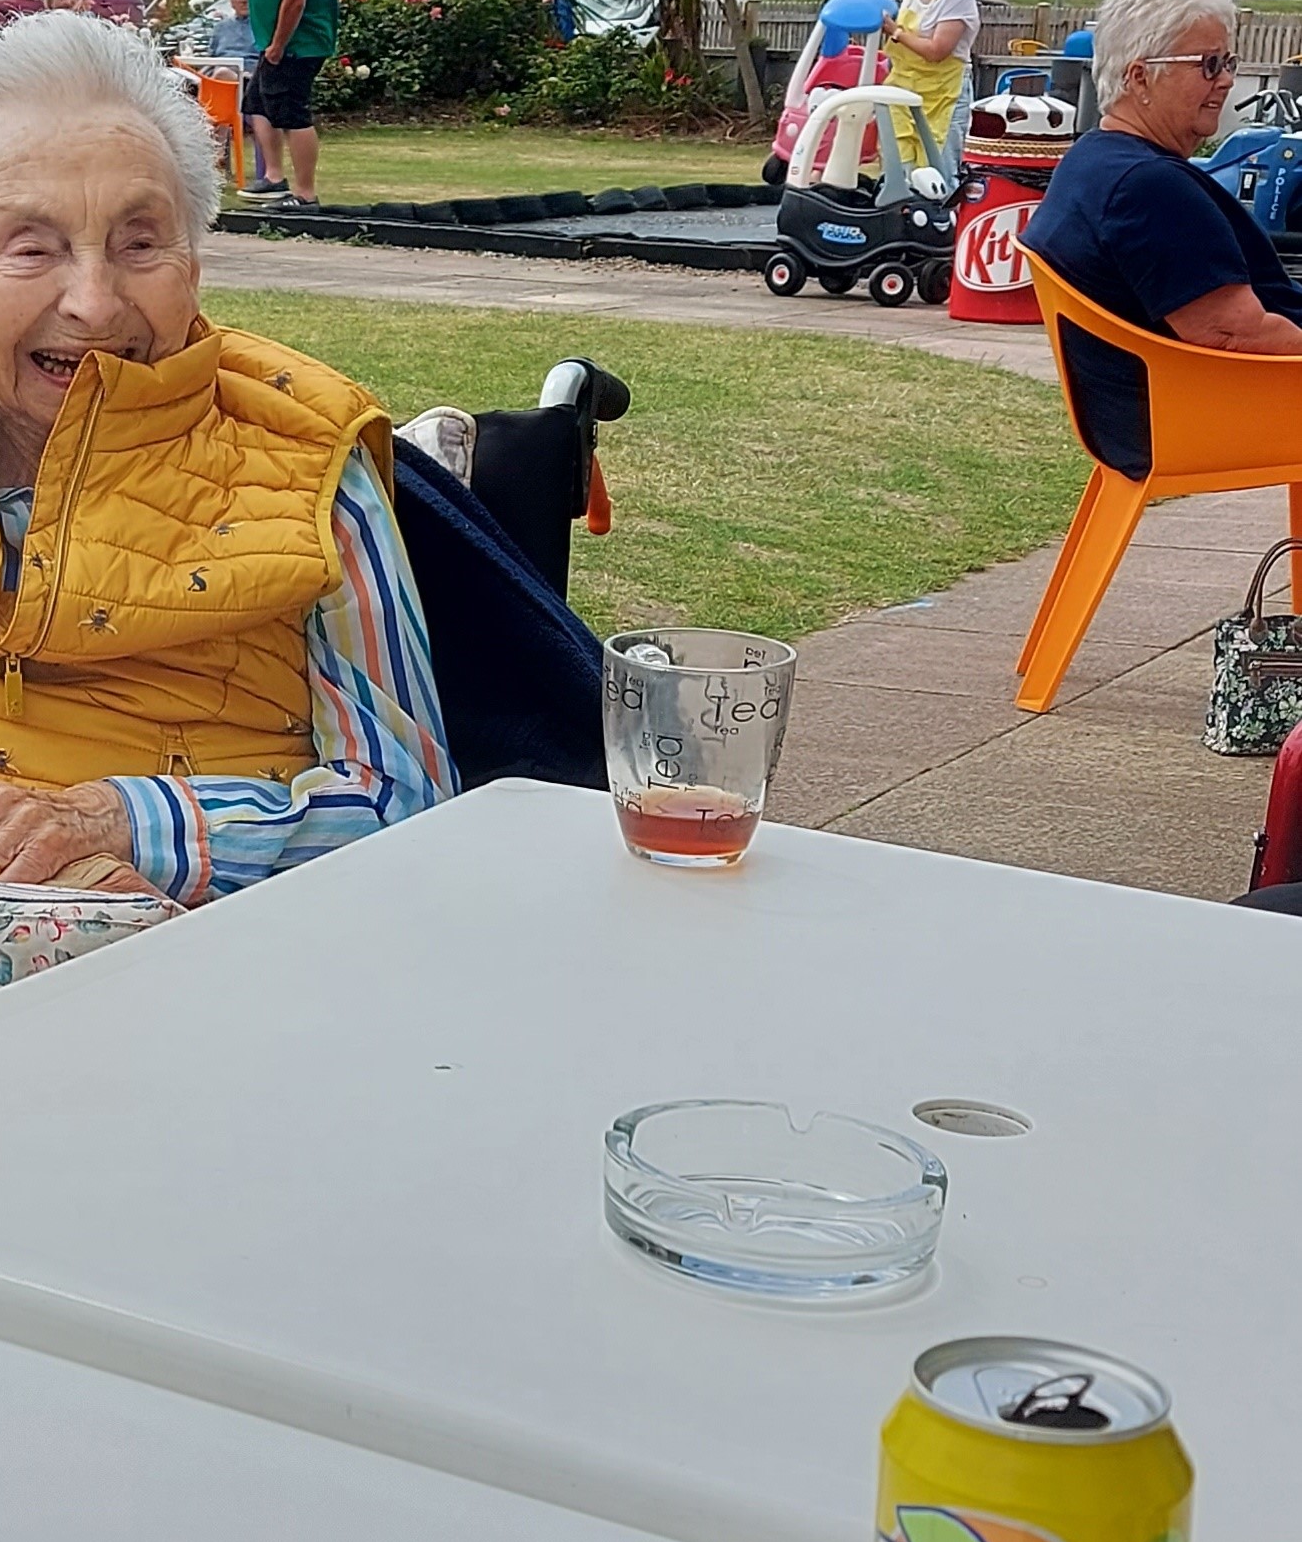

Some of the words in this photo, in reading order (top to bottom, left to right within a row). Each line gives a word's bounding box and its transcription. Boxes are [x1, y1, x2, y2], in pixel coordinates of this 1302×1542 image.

[1269, 167, 1286, 220] POLICE
[710, 695, 780, 722] Tea
[714, 725, 739, 735] Tea
[648, 734, 683, 790] Tea
[684, 773, 698, 792] Tea
